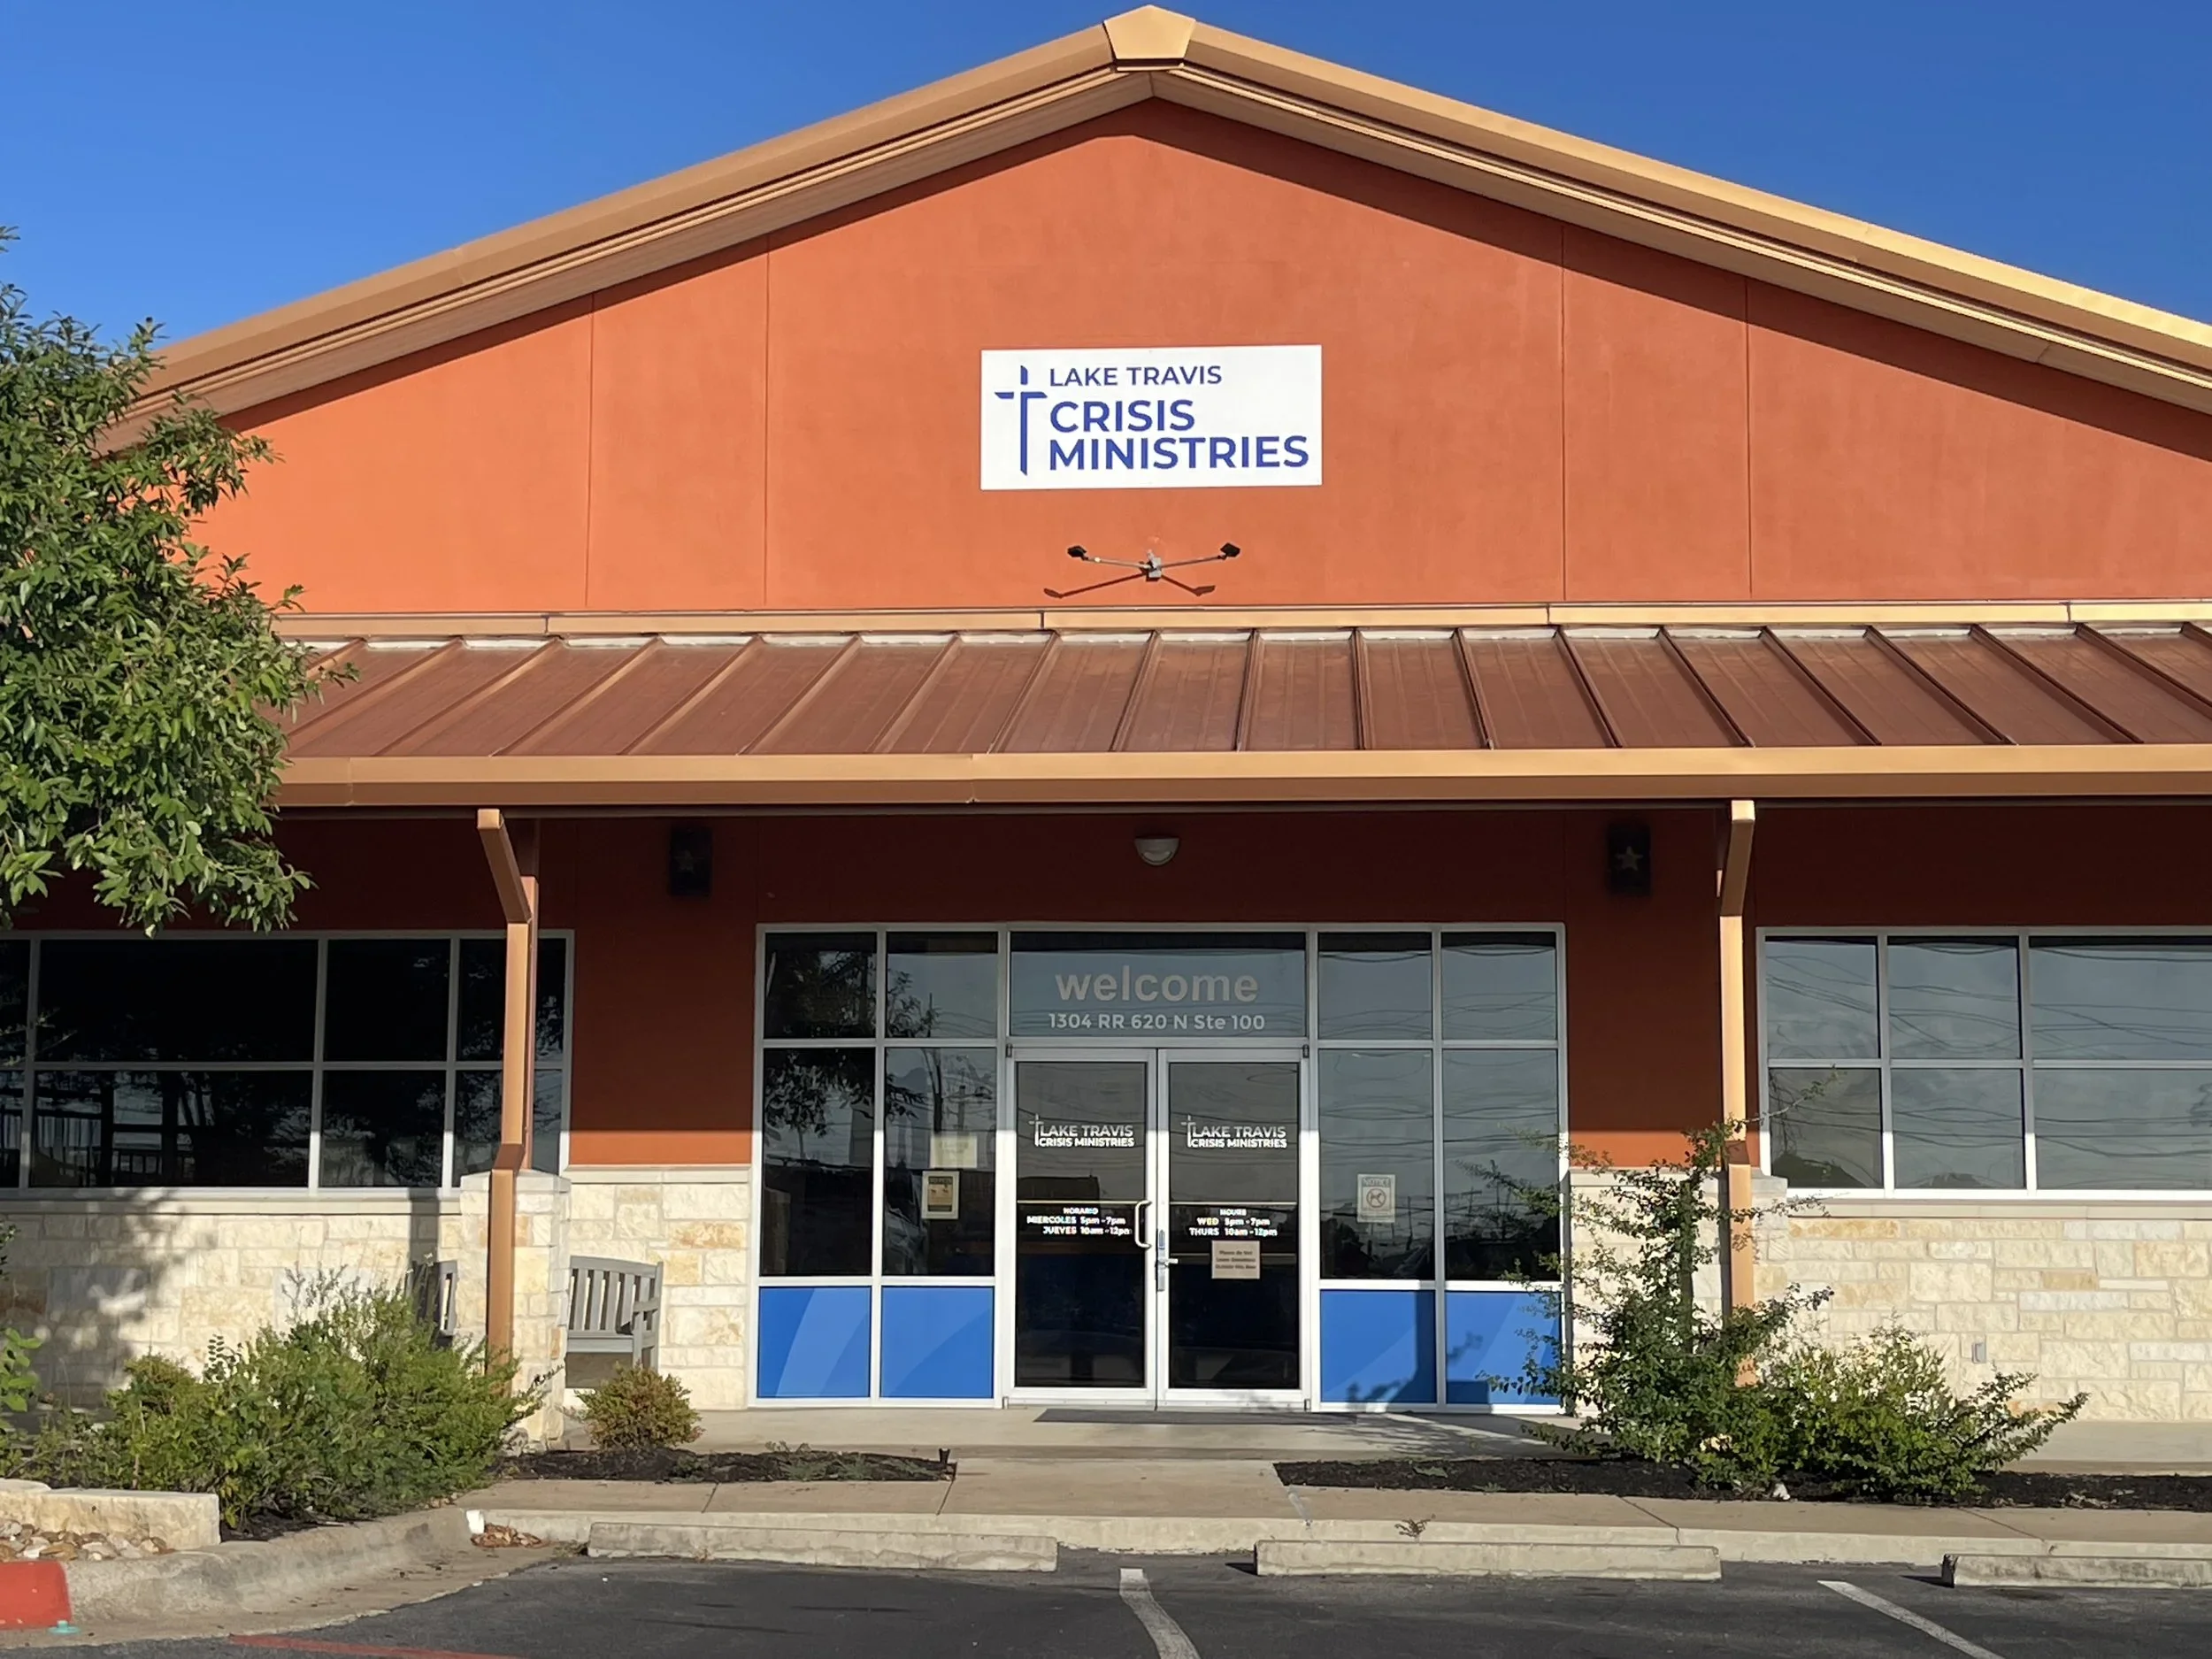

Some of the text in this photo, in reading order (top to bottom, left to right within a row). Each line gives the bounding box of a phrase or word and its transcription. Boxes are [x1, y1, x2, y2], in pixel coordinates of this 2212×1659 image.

[1049, 365, 1223, 387] LAKE TRAVIS
[1049, 399, 1195, 433] CRISIS
[1049, 435, 1310, 471] MINISTRIES
[1055, 964, 1259, 1002] welcome
[1048, 1013, 1265, 1030] 1304 RR 620 N Ste 100
[1041, 1125, 1133, 1137] LAKE TRAVIS
[1192, 1125, 1286, 1138] LAKE TRAVIS
[1039, 1138, 1134, 1147] CRISIS MINISTRIES
[1191, 1139, 1286, 1148] CRISIS MINISTRIES
[1189, 1227, 1219, 1236] THURS
